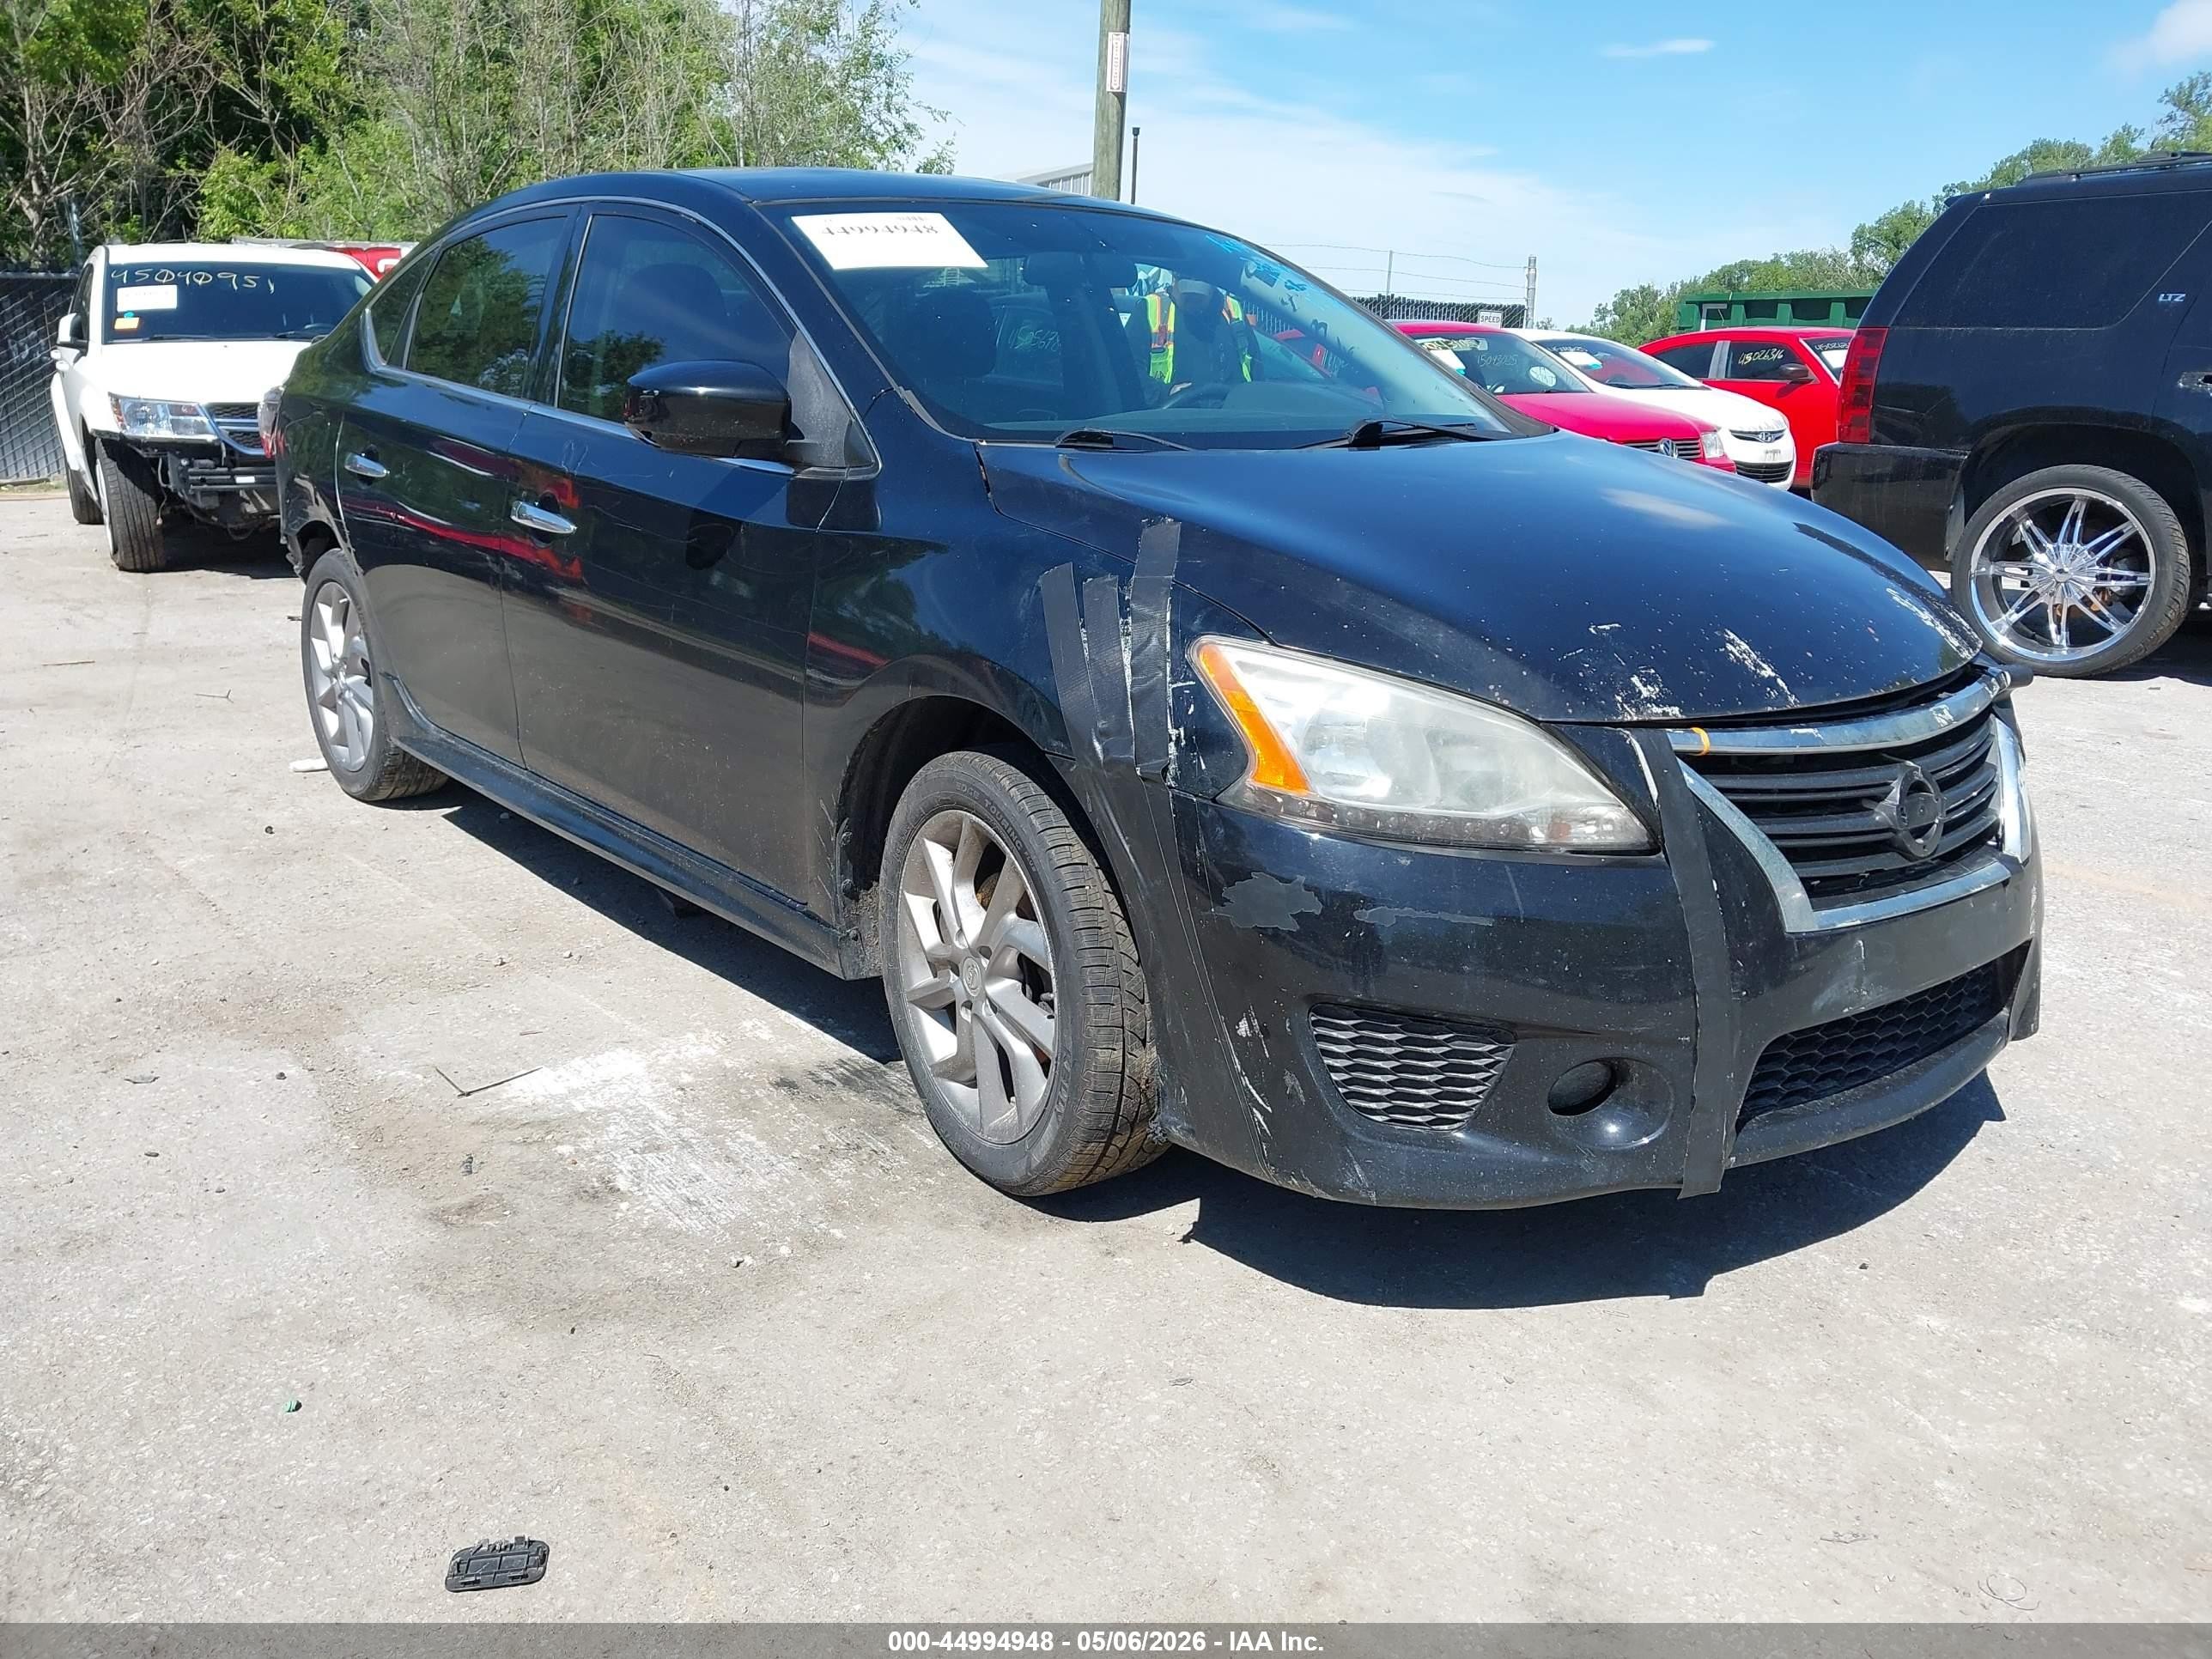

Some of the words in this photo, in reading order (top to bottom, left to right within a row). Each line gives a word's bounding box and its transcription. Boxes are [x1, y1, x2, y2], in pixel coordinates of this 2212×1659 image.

[2158, 293, 2186, 301] LTZ
[1738, 348, 1785, 365] 45026316
[983, 799, 1024, 850] TOURING
